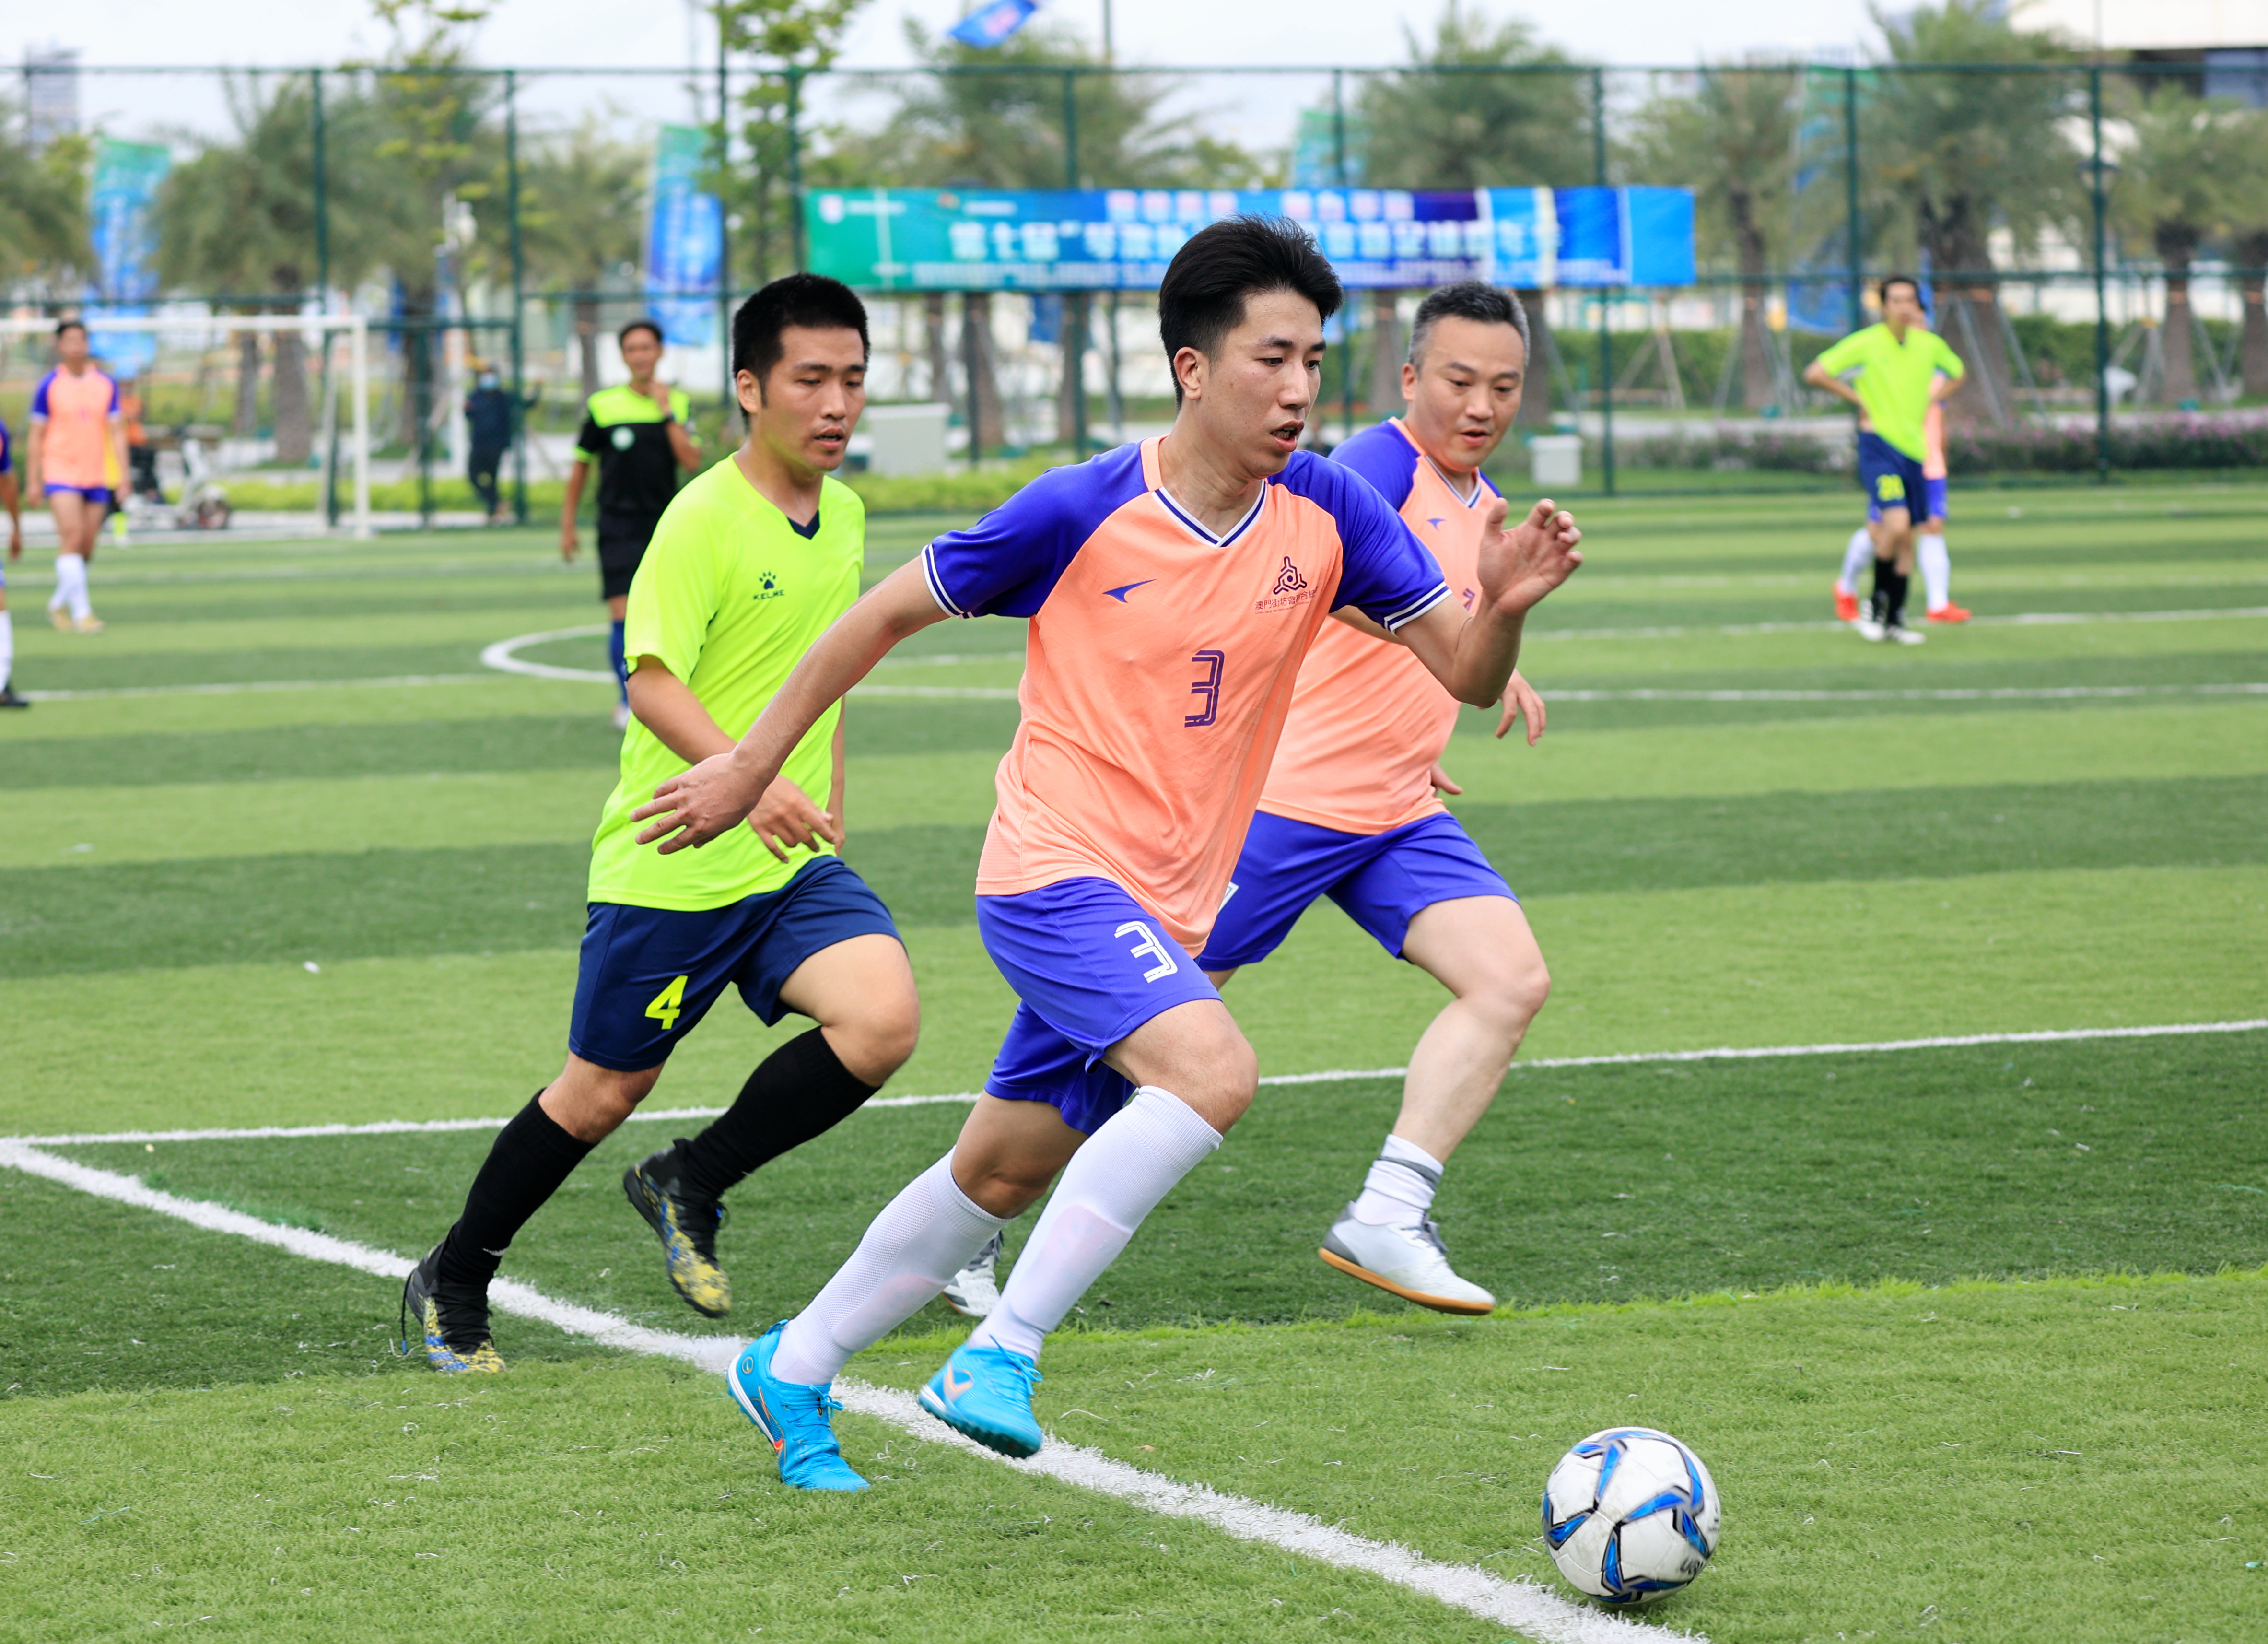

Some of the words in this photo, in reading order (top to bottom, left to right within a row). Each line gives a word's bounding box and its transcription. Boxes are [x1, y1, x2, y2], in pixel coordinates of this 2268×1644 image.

[754, 590, 784, 600] KELME
[1184, 650, 1225, 728] 3
[1114, 920, 1178, 983] 3
[644, 975, 688, 1030] 4
